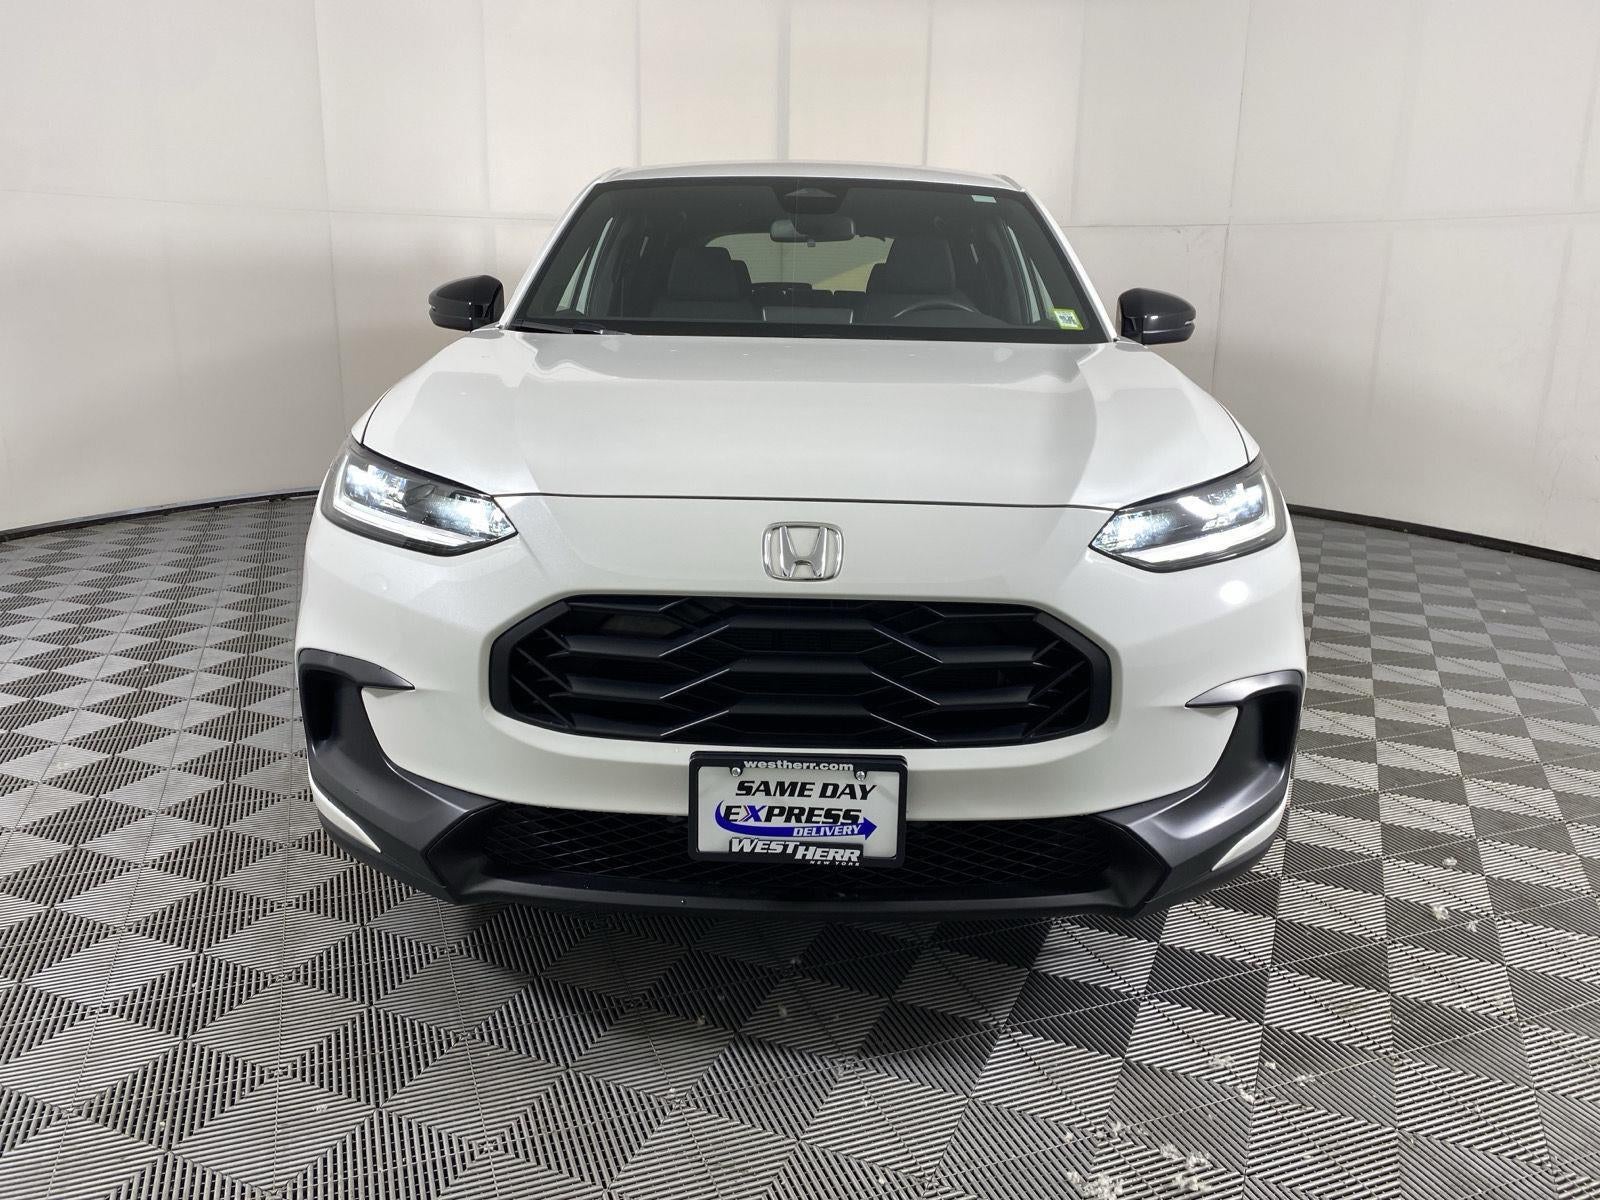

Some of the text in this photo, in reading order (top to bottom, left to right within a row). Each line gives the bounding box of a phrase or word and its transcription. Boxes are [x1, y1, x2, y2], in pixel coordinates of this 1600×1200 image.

[743, 760, 854, 771] westherr.com
[735, 780, 877, 800] SAME DAY
[723, 805, 862, 825] EXPRESS
[792, 824, 863, 837] DELIVERY
